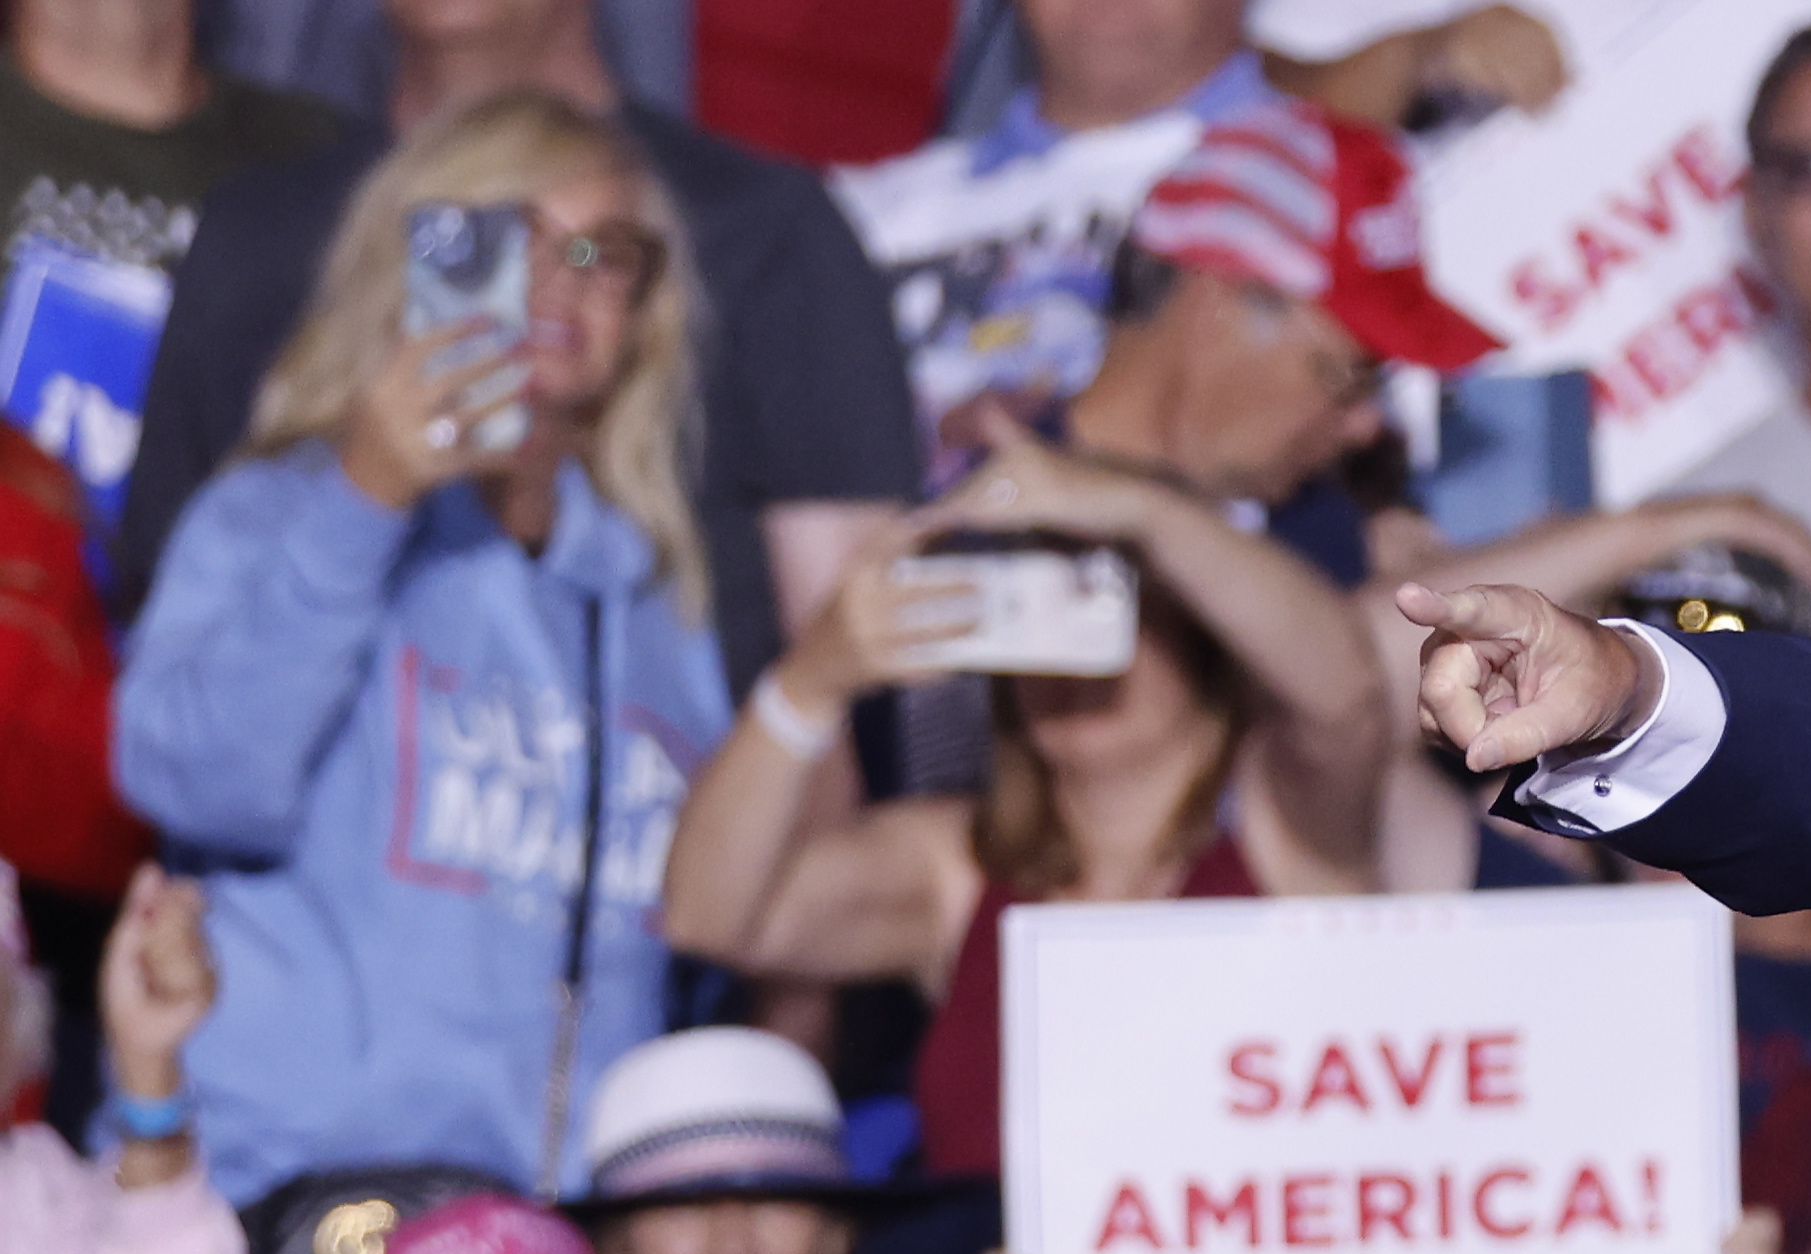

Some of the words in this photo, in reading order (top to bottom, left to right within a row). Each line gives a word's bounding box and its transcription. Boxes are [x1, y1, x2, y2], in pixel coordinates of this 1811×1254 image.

[1510, 126, 1750, 330] SAVE
[1226, 1030, 1524, 1117] SAVE
[1094, 1159, 1662, 1254] AMERICA!
